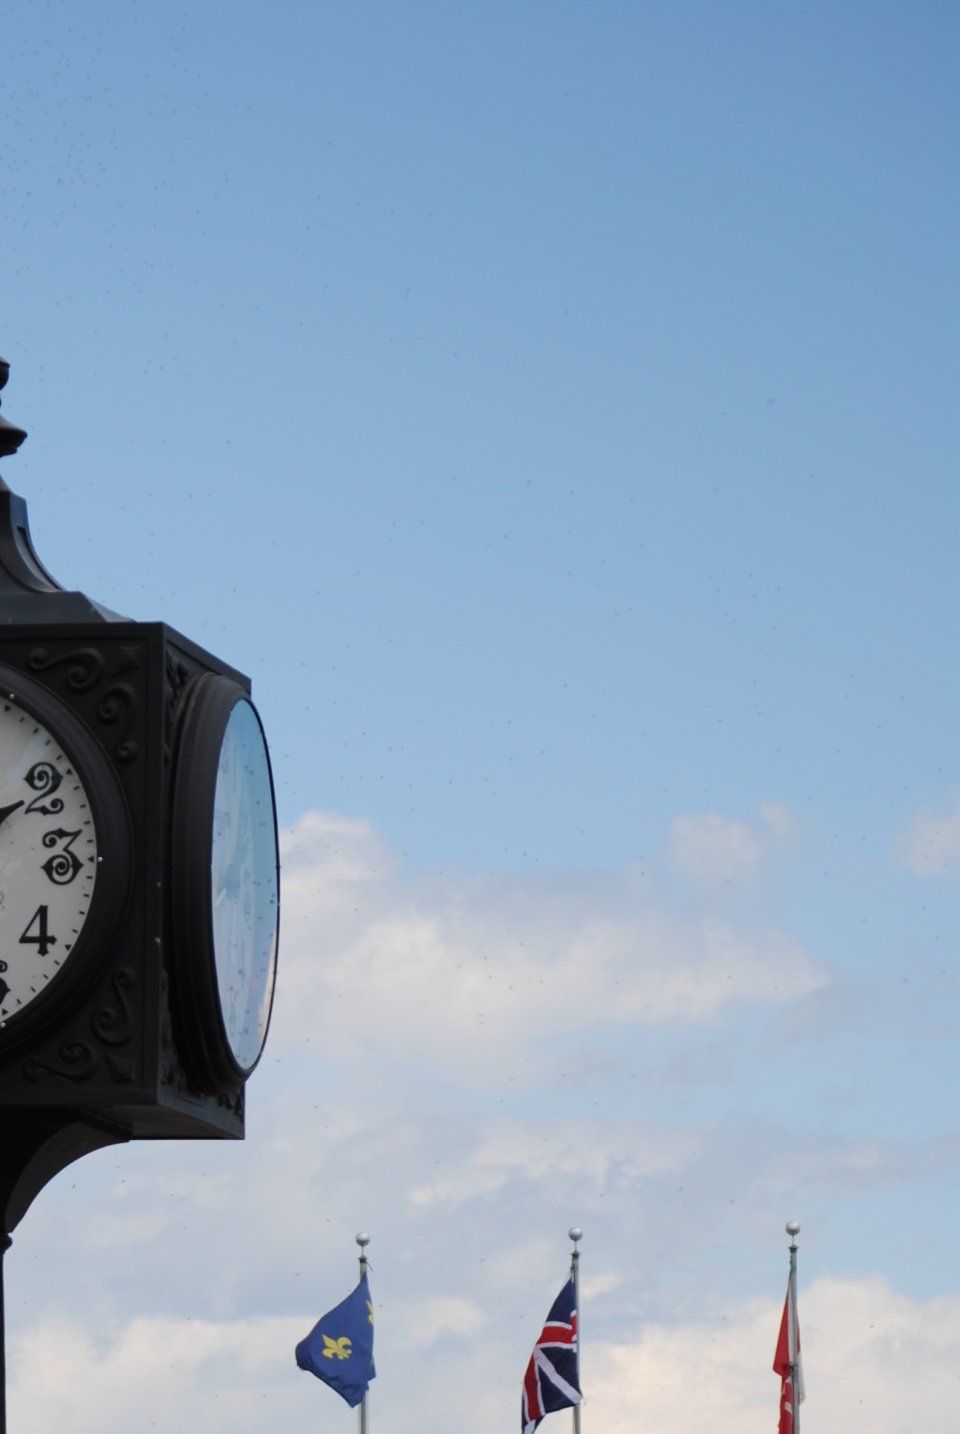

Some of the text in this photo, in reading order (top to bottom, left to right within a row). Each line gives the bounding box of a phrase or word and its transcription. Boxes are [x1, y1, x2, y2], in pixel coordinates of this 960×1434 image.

[23, 761, 64, 816] 2
[41, 828, 84, 885] 3
[19, 904, 57, 956] 4
